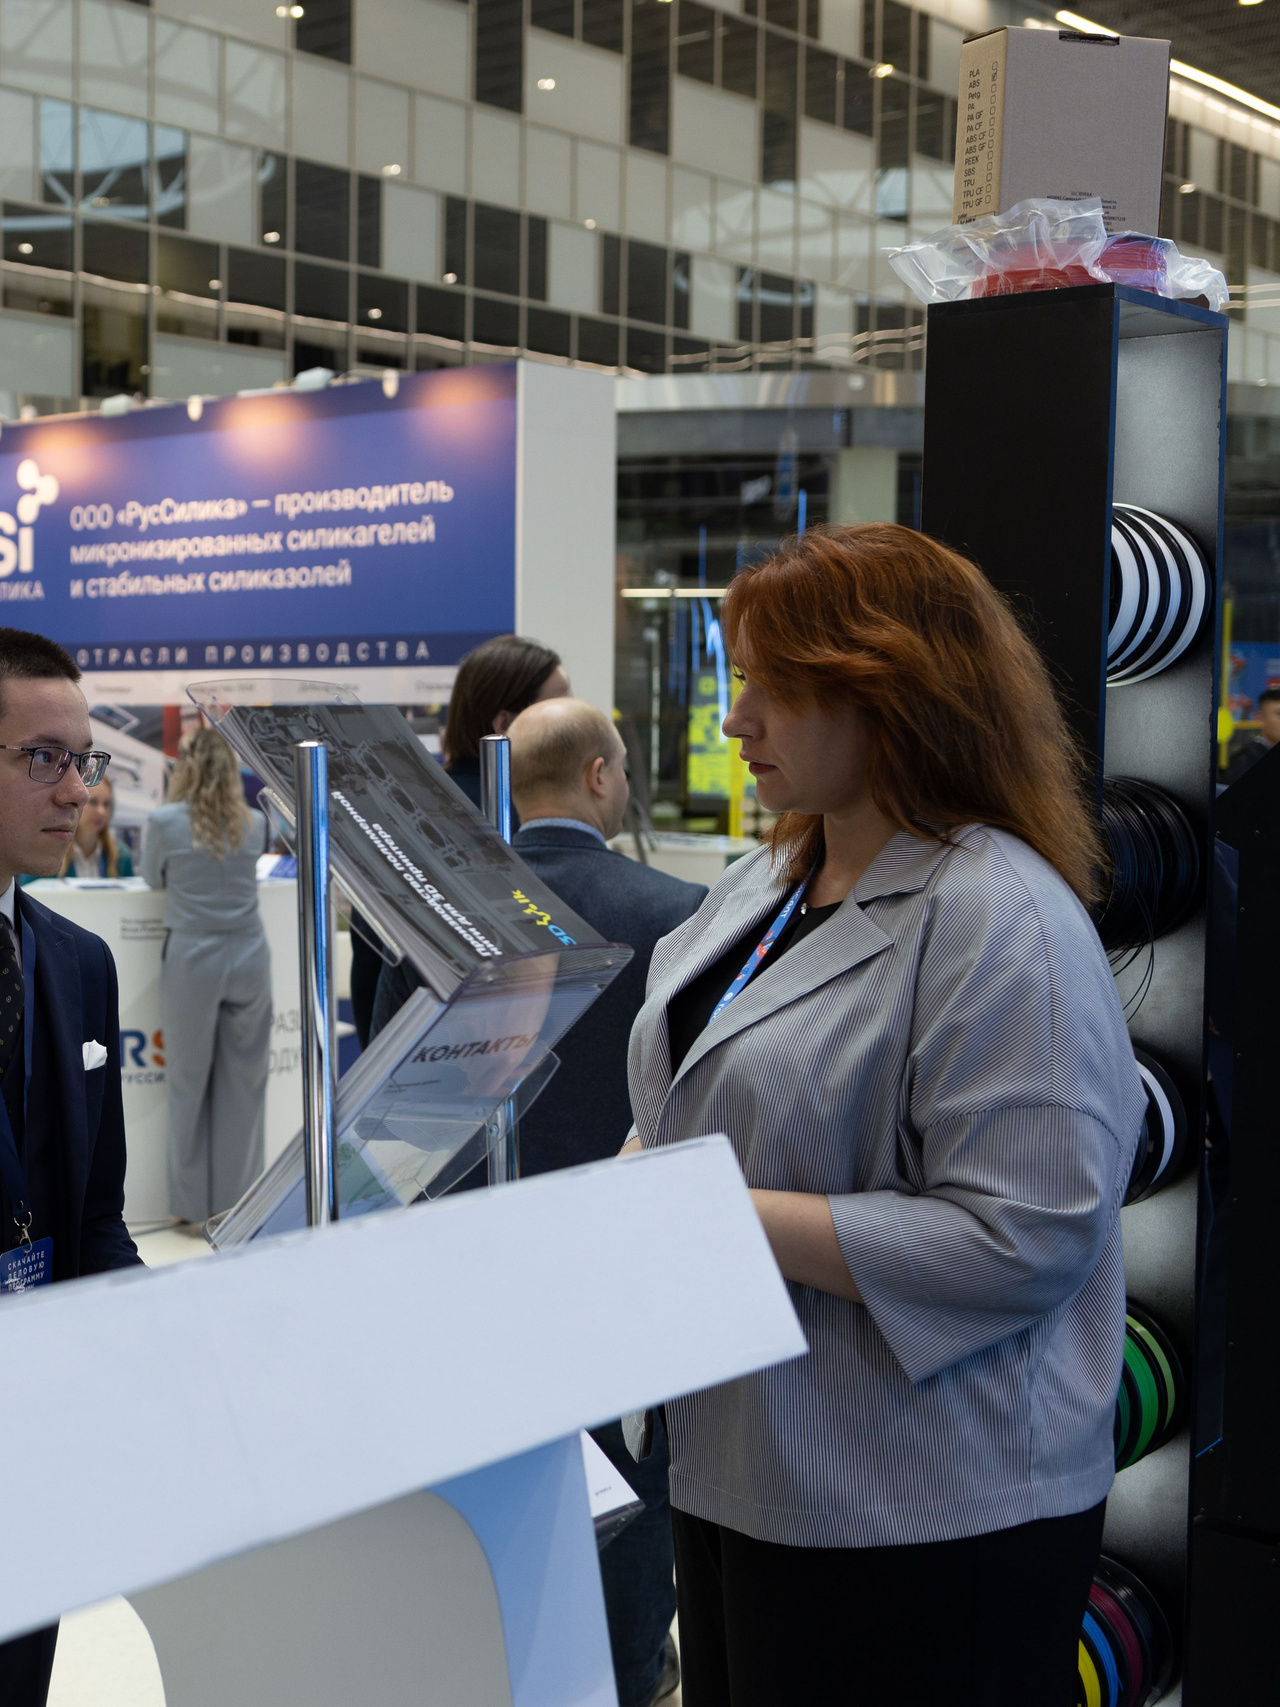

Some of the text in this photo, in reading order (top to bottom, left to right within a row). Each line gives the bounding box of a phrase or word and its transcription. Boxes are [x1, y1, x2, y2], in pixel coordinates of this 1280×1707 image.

[968, 68, 980, 78] PLA
[968, 79, 980, 89] ABS
[967, 103, 975, 111] PA
[967, 110, 983, 122] PA GF
[966, 121, 983, 133] PA CF
[965, 131, 987, 144] ABS CF
[965, 145, 977, 155] ABS
[964, 155, 979, 166] PEEK
[964, 167, 976, 178] SBS
[963, 178, 975, 188] TPU
[962, 186, 984, 199] TPU CF
[962, 200, 974, 210] TPU
[70, 502, 114, 531] ООО
[116, 498, 248, 532] «РусСилика»
[275, 480, 455, 520] производитель
[70, 514, 436, 568] микронизированных силикагелей
[70, 558, 352, 600] и стабильных силиказолей
[76, 640, 430, 667] ОТРАСЛИ ПРОИЗВОДСТВА
[330, 790, 493, 957] Производство полимерной
[371, 823, 503, 956] нити для 3D принтера
[411, 1031, 540, 1063] КОНТАКТЫ
[7, 1250, 45, 1271] СКАЧАЙТЕ
